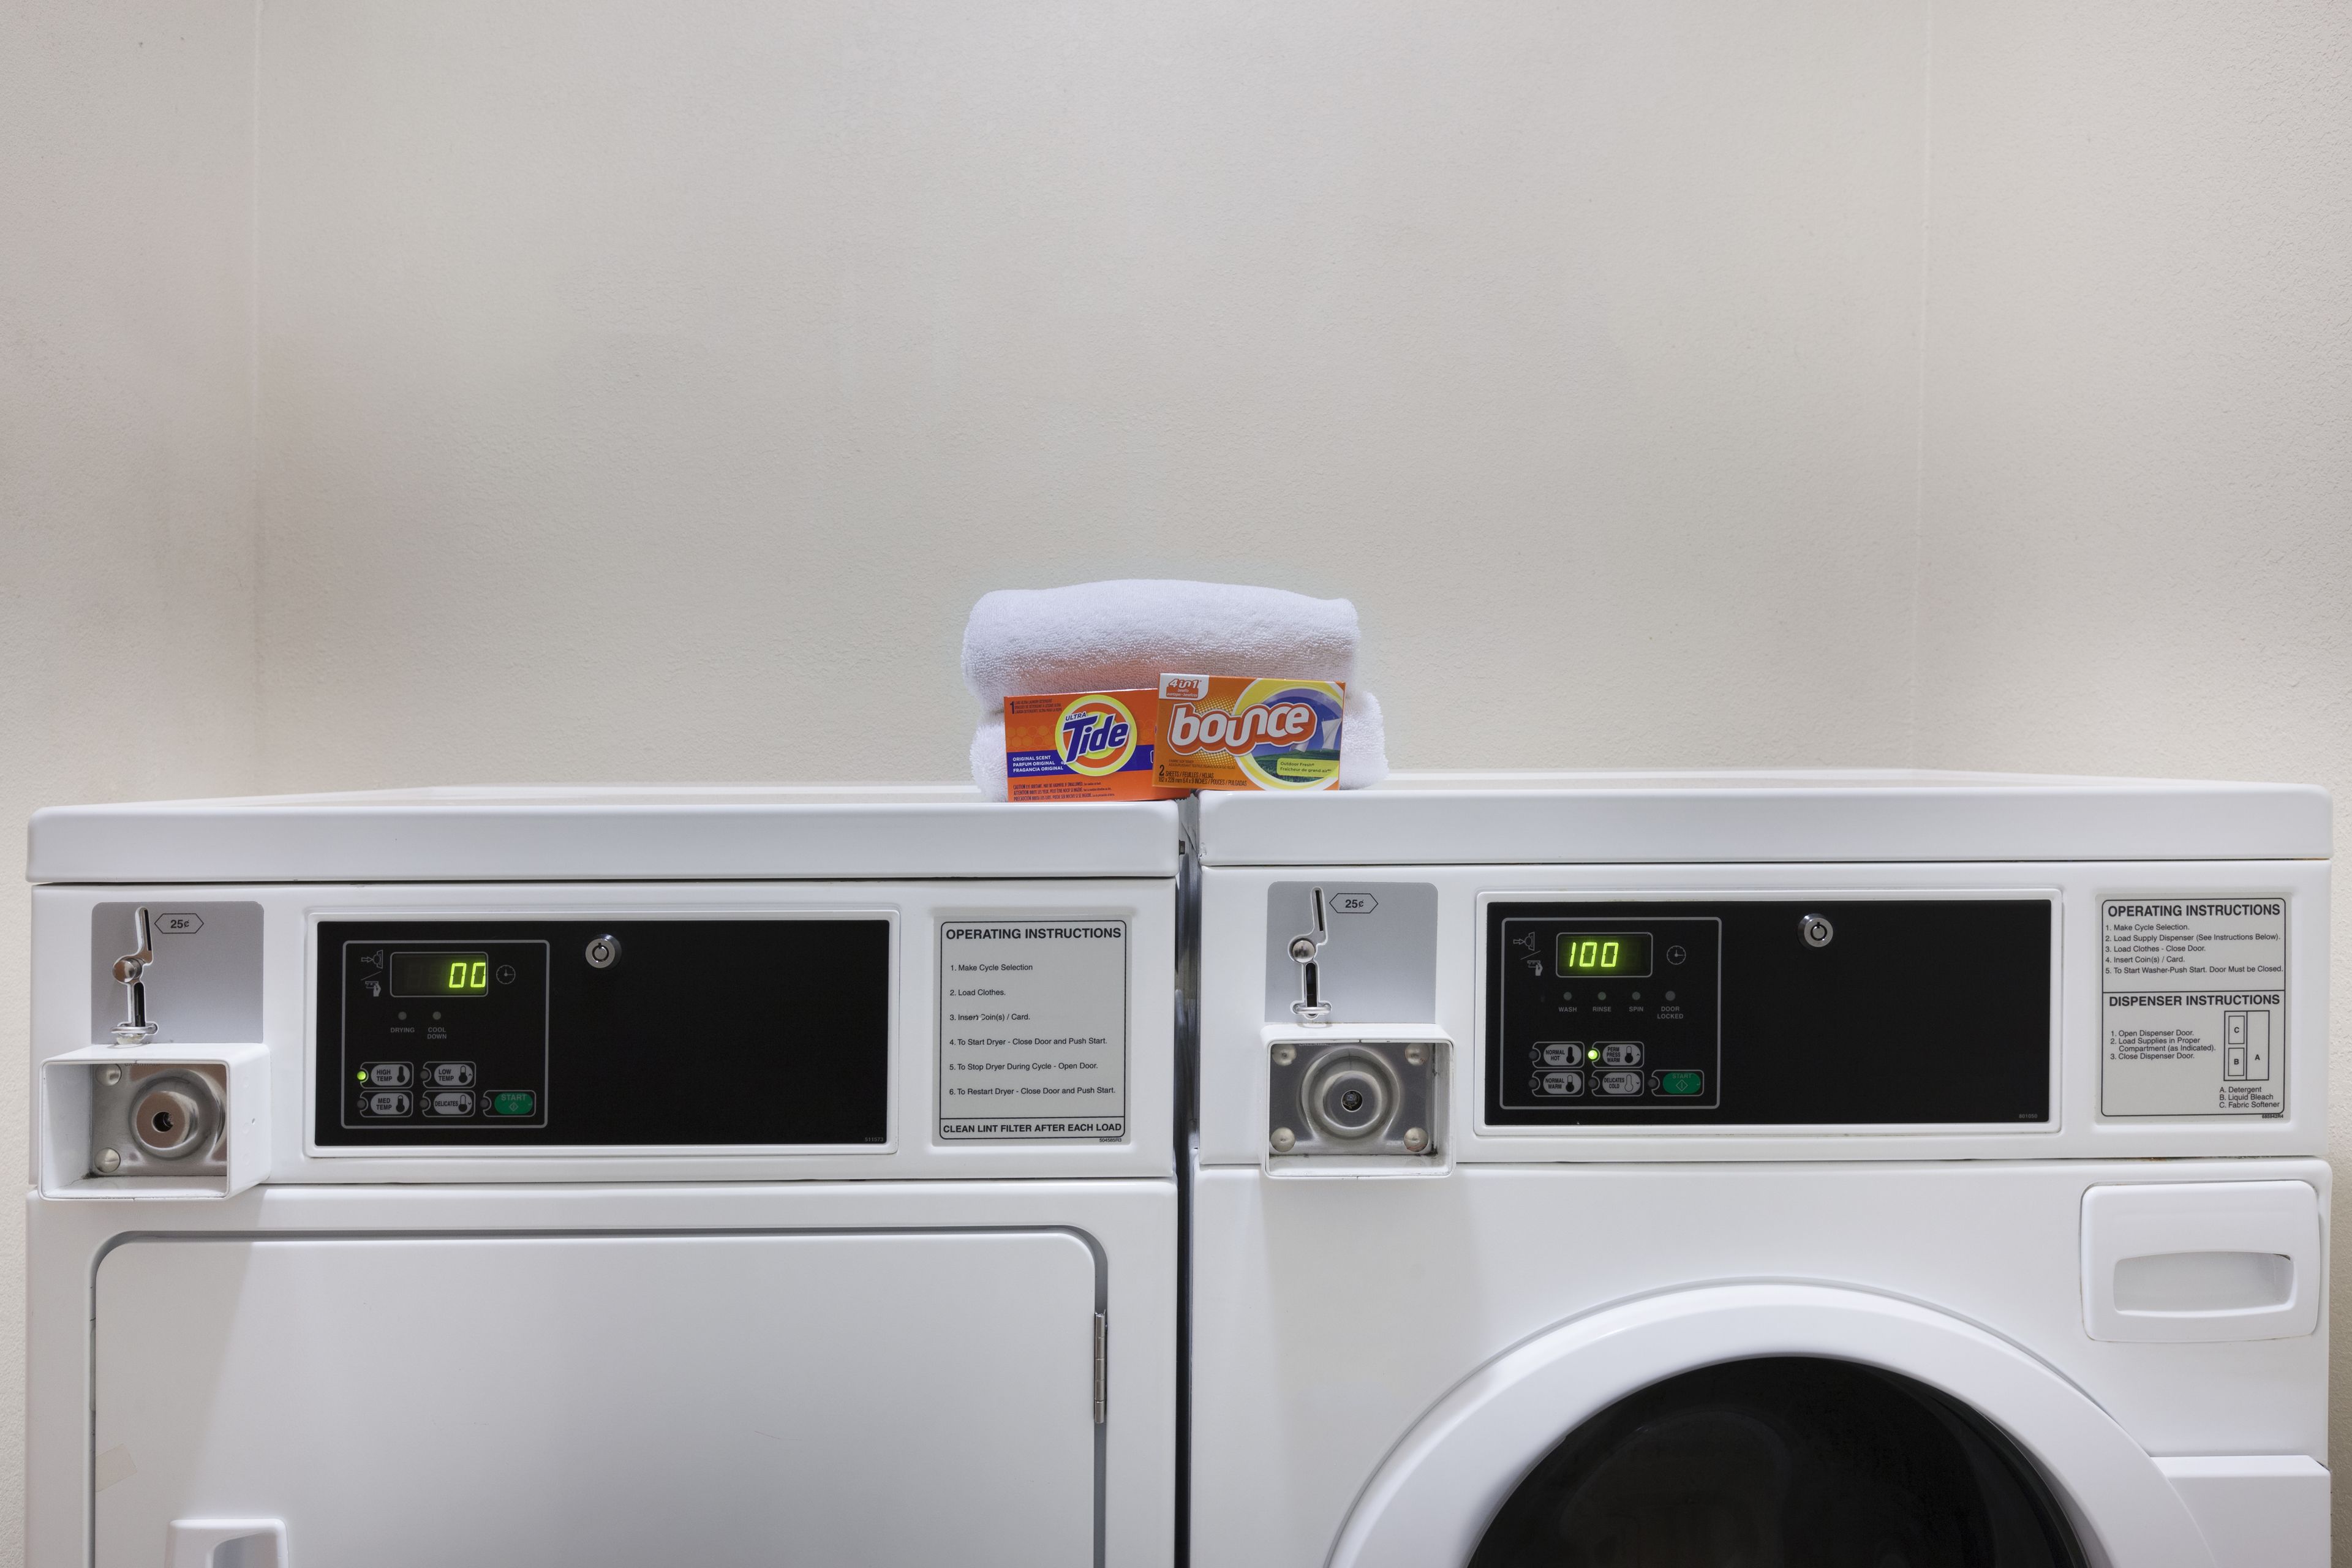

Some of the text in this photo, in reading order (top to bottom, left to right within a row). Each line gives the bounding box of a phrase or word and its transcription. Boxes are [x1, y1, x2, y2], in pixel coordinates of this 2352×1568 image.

[1009, 701, 1015, 714] 1
[1065, 712, 1087, 721] ULTRA
[1170, 706, 1310, 747] bounce
[1063, 714, 1129, 763] Tide
[1159, 764, 1165, 776] 2
[1345, 899, 1364, 908] 25¢
[2108, 903, 2280, 918] OPERATING INSTRUCTIONS
[170, 919, 190, 929] 25¢
[2134, 924, 2154, 932] Cycle
[946, 927, 1121, 940] OPERATING INSTRUCTIONS
[2159, 934, 2194, 943] Dispenser
[2196, 933, 2212, 942] (See
[2255, 933, 2280, 941] Below).
[1569, 941, 1619, 968] 100
[2135, 956, 2160, 964] Coin(s)
[979, 964, 999, 973] Cycle
[448, 962, 486, 989] 00
[2109, 994, 2280, 1006] DISPENSER INSTRUCTIONS
[2118, 1030, 2138, 1038] Open
[986, 1038, 1006, 1047] Dryer
[2138, 1037, 2167, 1046] Supplies
[2177, 1036, 2201, 1045] Proper
[2119, 1045, 2166, 1054] Compartment
[2139, 1052, 2175, 1061] Dispenser
[967, 1063, 984, 1072] Stop
[986, 1063, 1005, 1072] Dryer
[1007, 1063, 1030, 1071] During
[1031, 1063, 1052, 1071] Cycle
[1058, 1062, 1077, 1071] Open
[995, 1088, 1015, 1096] Dryer
[2228, 1086, 2262, 1095] Detergent
[2228, 1093, 2248, 1102] Liquid
[943, 1125, 975, 1133] CLEAN
[1000, 1124, 1032, 1133] FILTER
[1068, 1123, 1093, 1132] EACH
